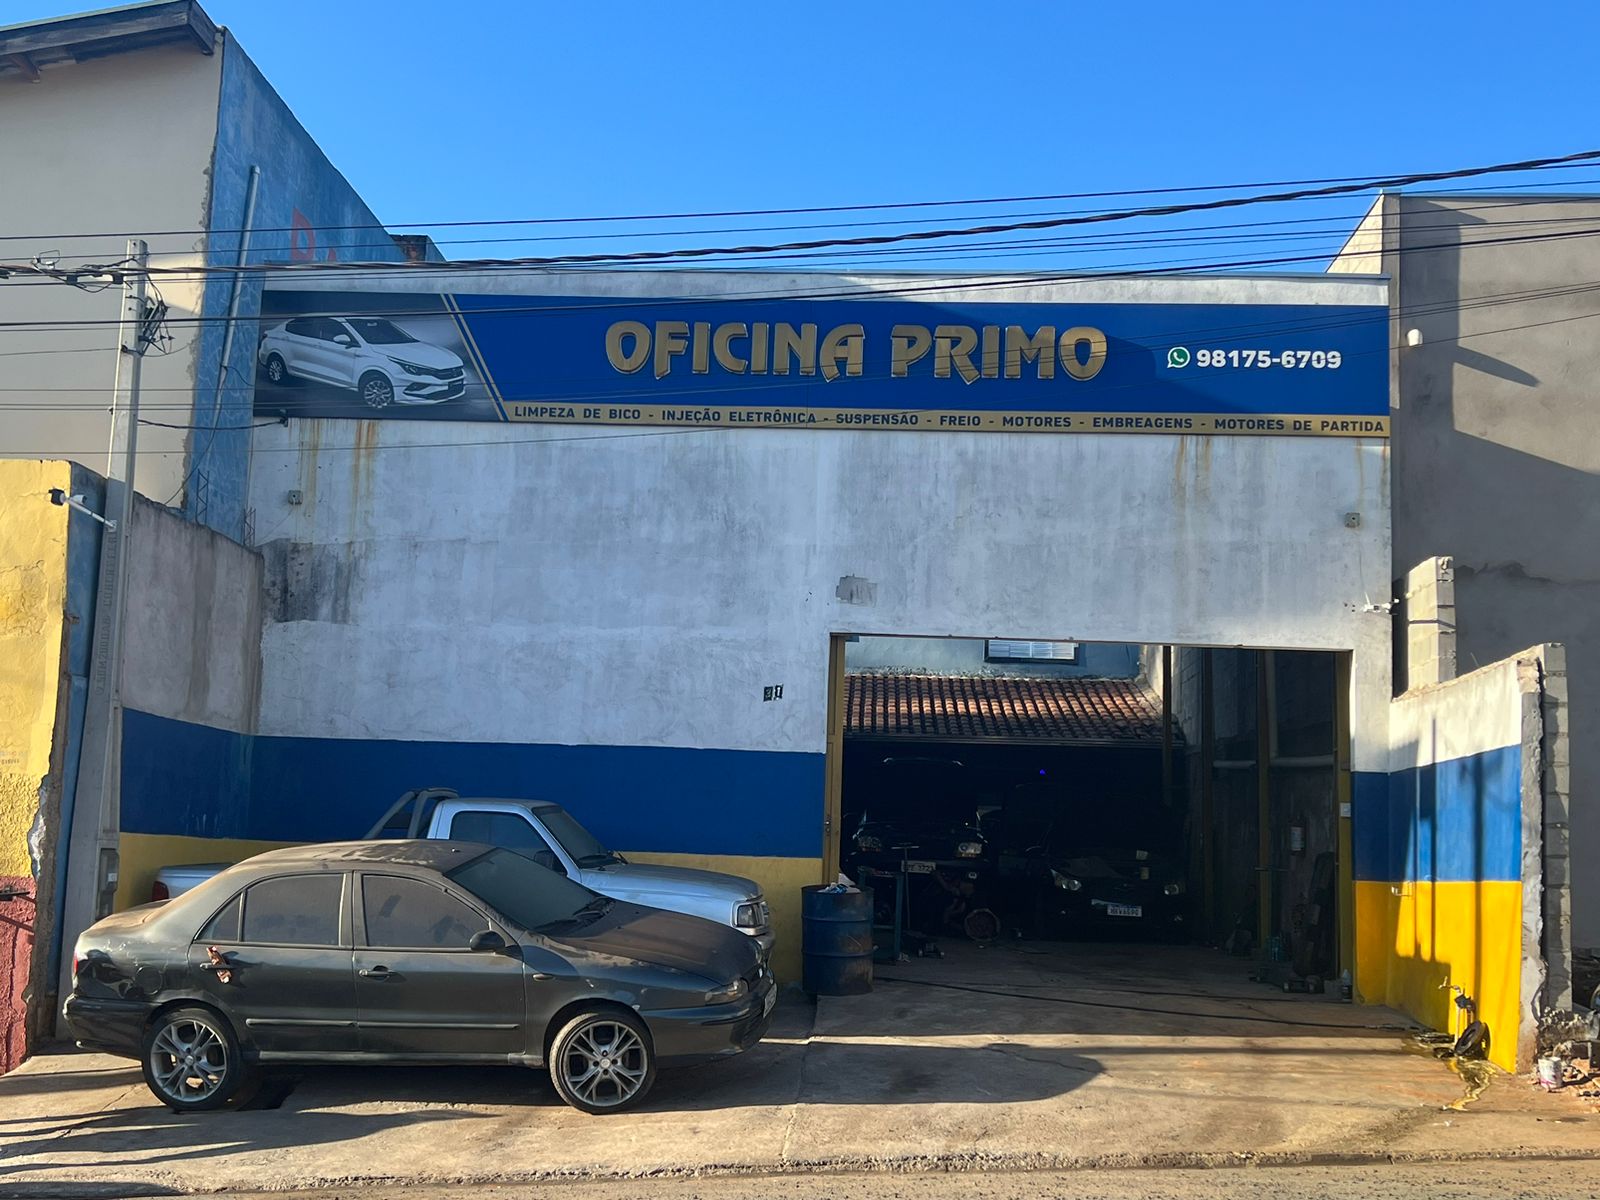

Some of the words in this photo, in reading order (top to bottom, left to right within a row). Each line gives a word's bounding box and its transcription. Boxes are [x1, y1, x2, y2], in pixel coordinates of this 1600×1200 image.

[605, 321, 865, 383] OFICINA
[891, 325, 1107, 385] PRIMO
[1196, 349, 1342, 369] 98175-6709
[514, 405, 576, 419] LIMPEZA
[583, 407, 601, 420] DE
[608, 407, 641, 420] BICO
[661, 407, 721, 424] INJEÇÃO
[729, 408, 817, 424] ELETRÔNICA
[835, 410, 919, 426] SUSPENSÃO
[939, 414, 981, 427] FREIO
[1002, 415, 1072, 428] MOTORES
[1092, 416, 1193, 430] EMBREAGENS
[1214, 418, 1285, 431] MOTORES
[1293, 419, 1313, 432] DE
[1320, 419, 1385, 433] PARTIDA
